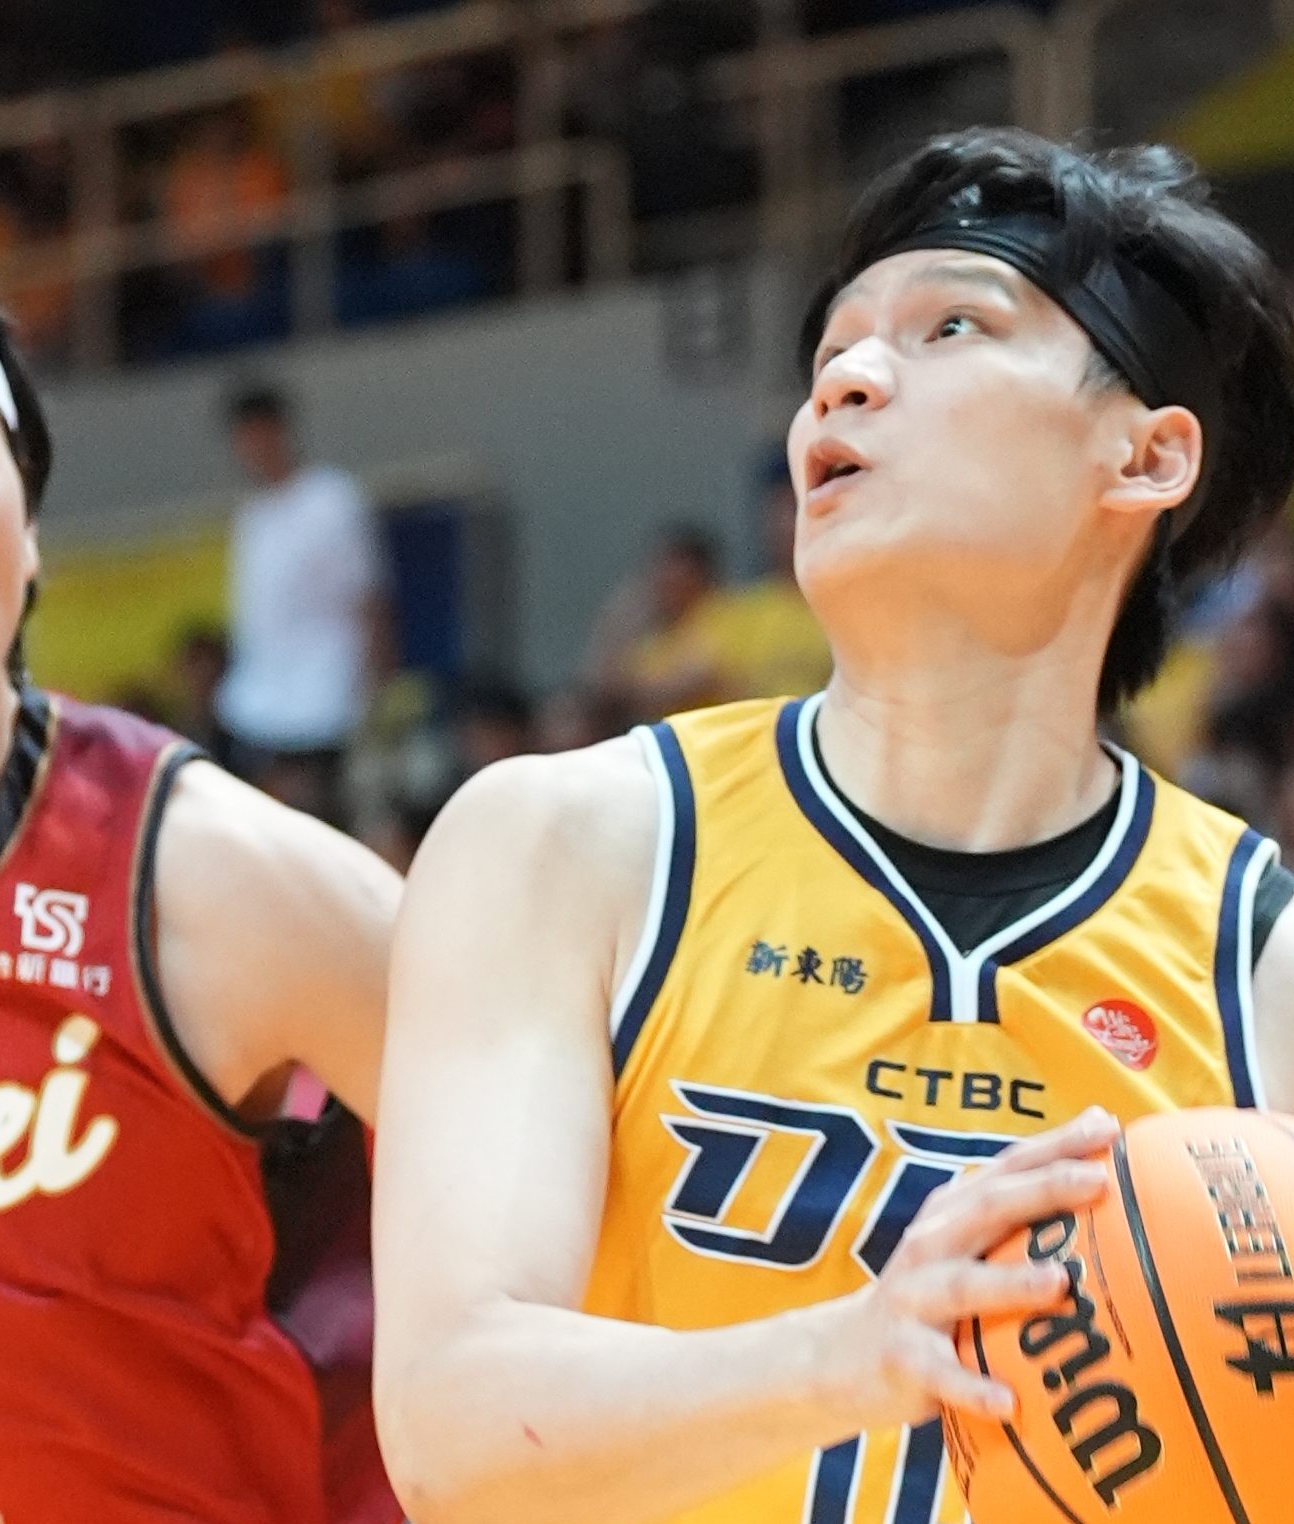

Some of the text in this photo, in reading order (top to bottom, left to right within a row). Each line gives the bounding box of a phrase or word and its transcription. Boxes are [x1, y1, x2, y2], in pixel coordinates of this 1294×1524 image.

[745, 939, 869, 995] 新東陽
[865, 1059, 1046, 1120] CTBC
